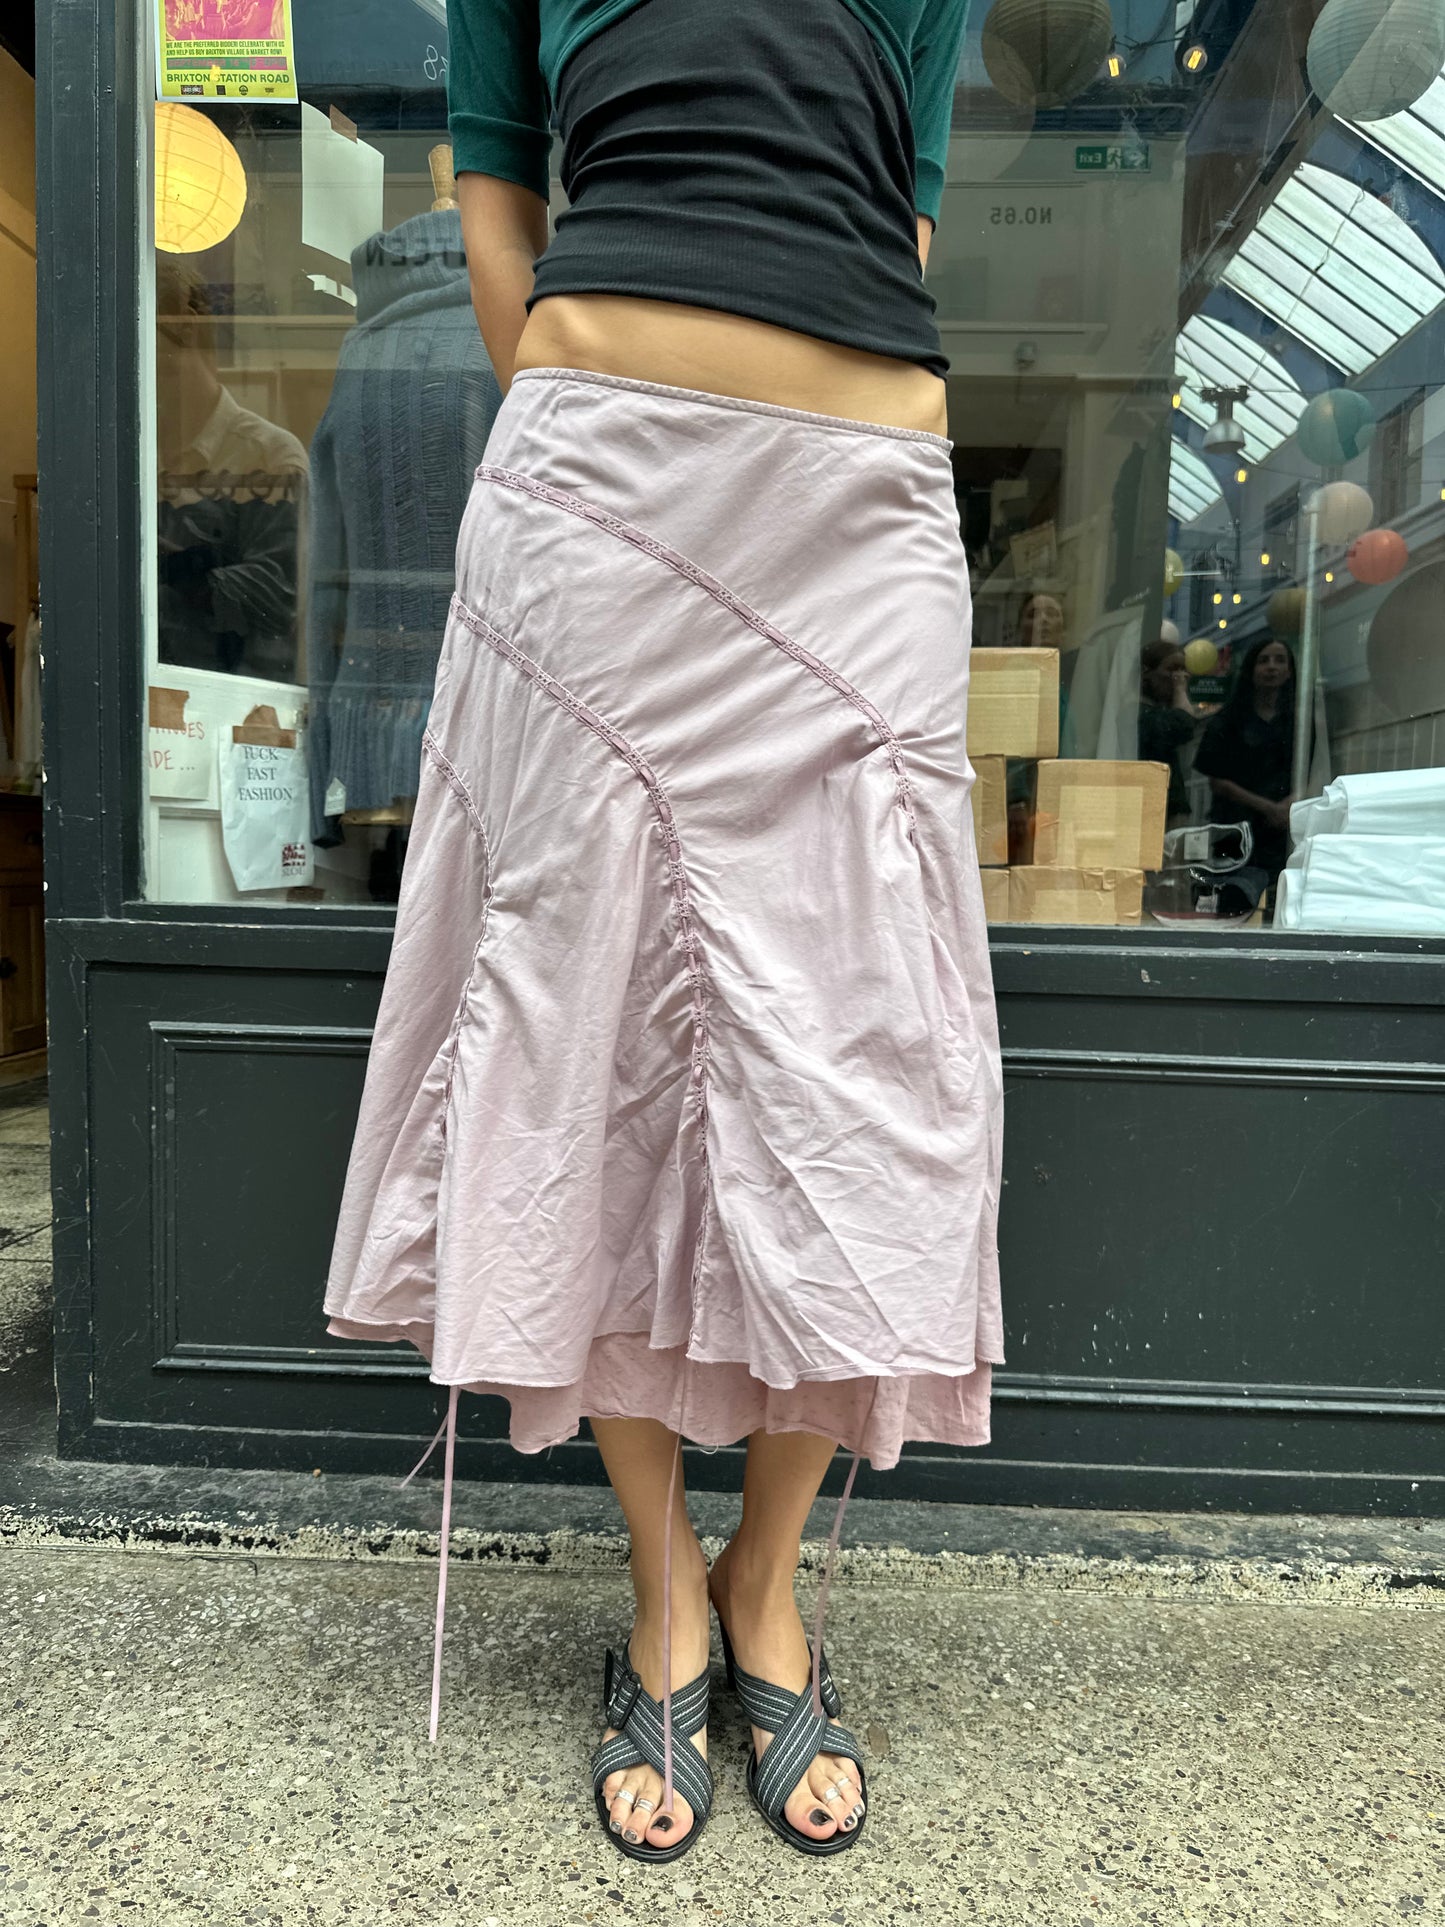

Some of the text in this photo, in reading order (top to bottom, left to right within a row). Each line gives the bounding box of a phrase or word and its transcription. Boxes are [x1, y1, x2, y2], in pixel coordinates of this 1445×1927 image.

[166, 73, 210, 82] BRIXTON
[260, 73, 290, 83] ROAD
[248, 767, 277, 780] FAST
[239, 787, 293, 801] FASHION
